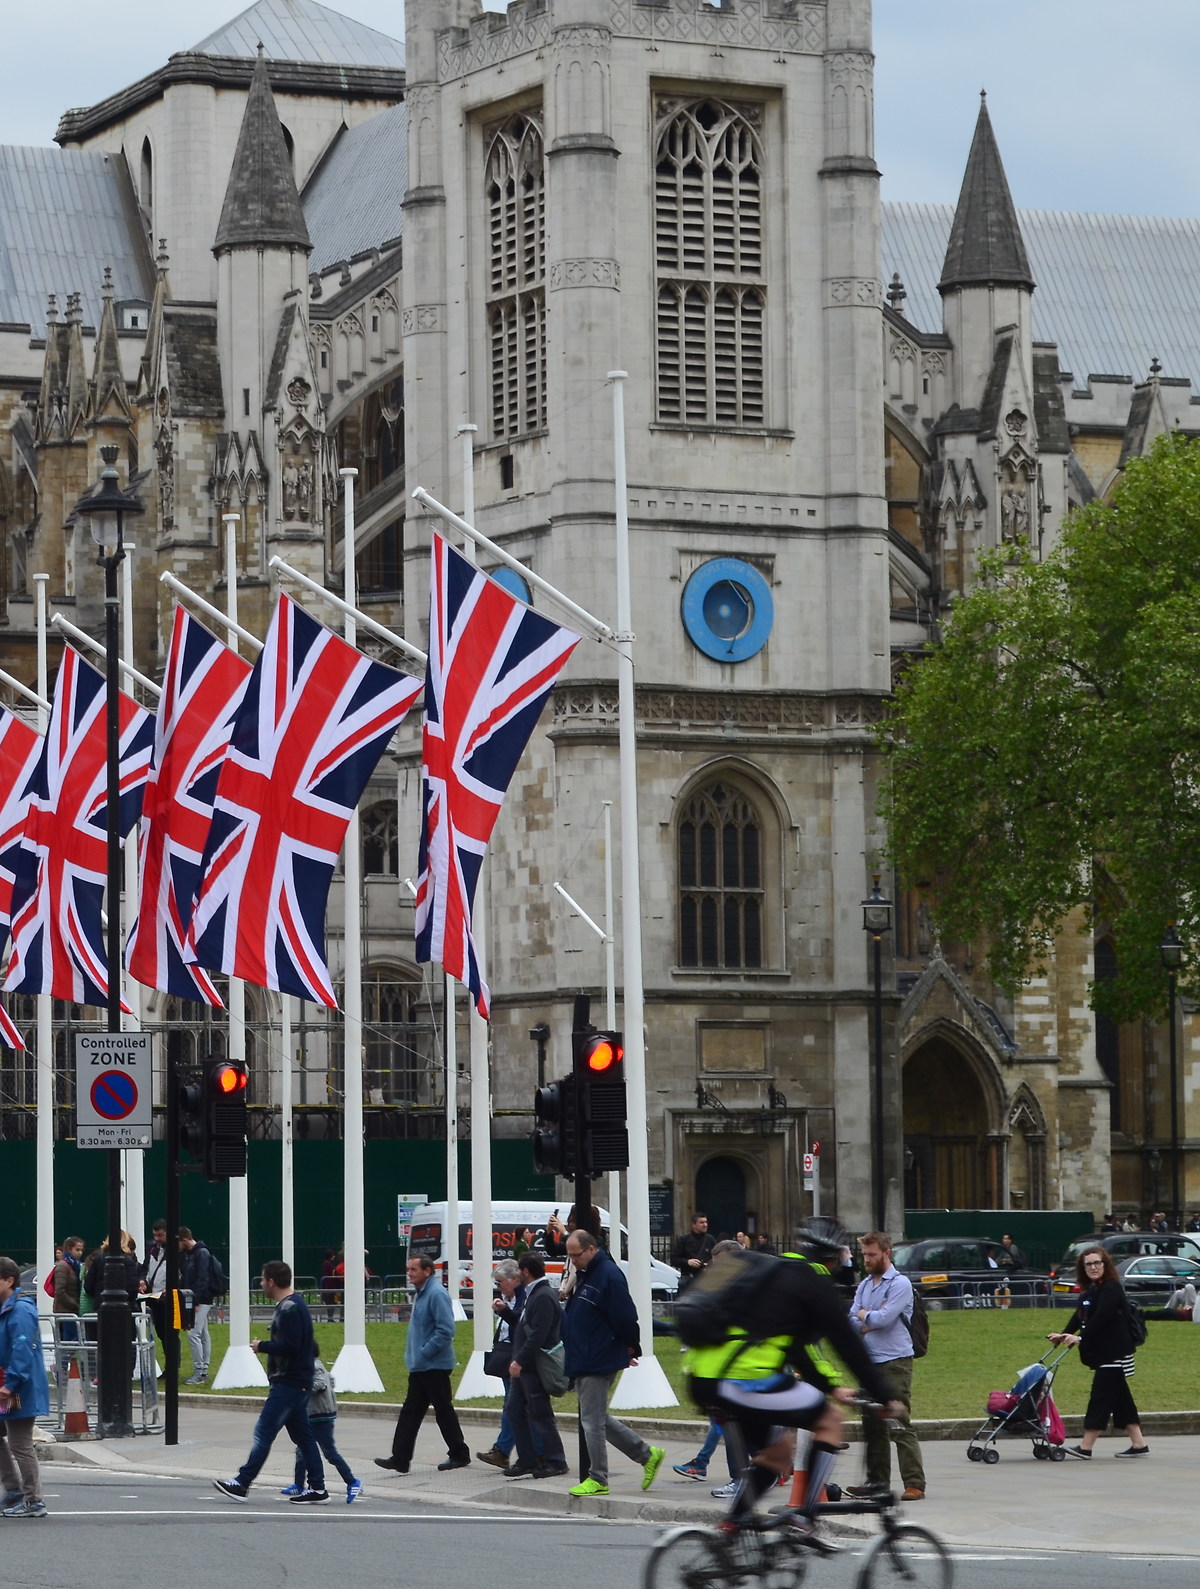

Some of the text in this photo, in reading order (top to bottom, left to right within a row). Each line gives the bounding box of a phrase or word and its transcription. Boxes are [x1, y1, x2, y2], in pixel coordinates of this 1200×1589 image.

[81, 1038, 146, 1049] Controlled
[90, 1052, 136, 1065] ZONE
[98, 1128, 115, 1136] Mon
[121, 1128, 132, 1136] Fri
[80, 1137, 99, 1146] 8.30
[117, 1137, 136, 1146] 6.30
